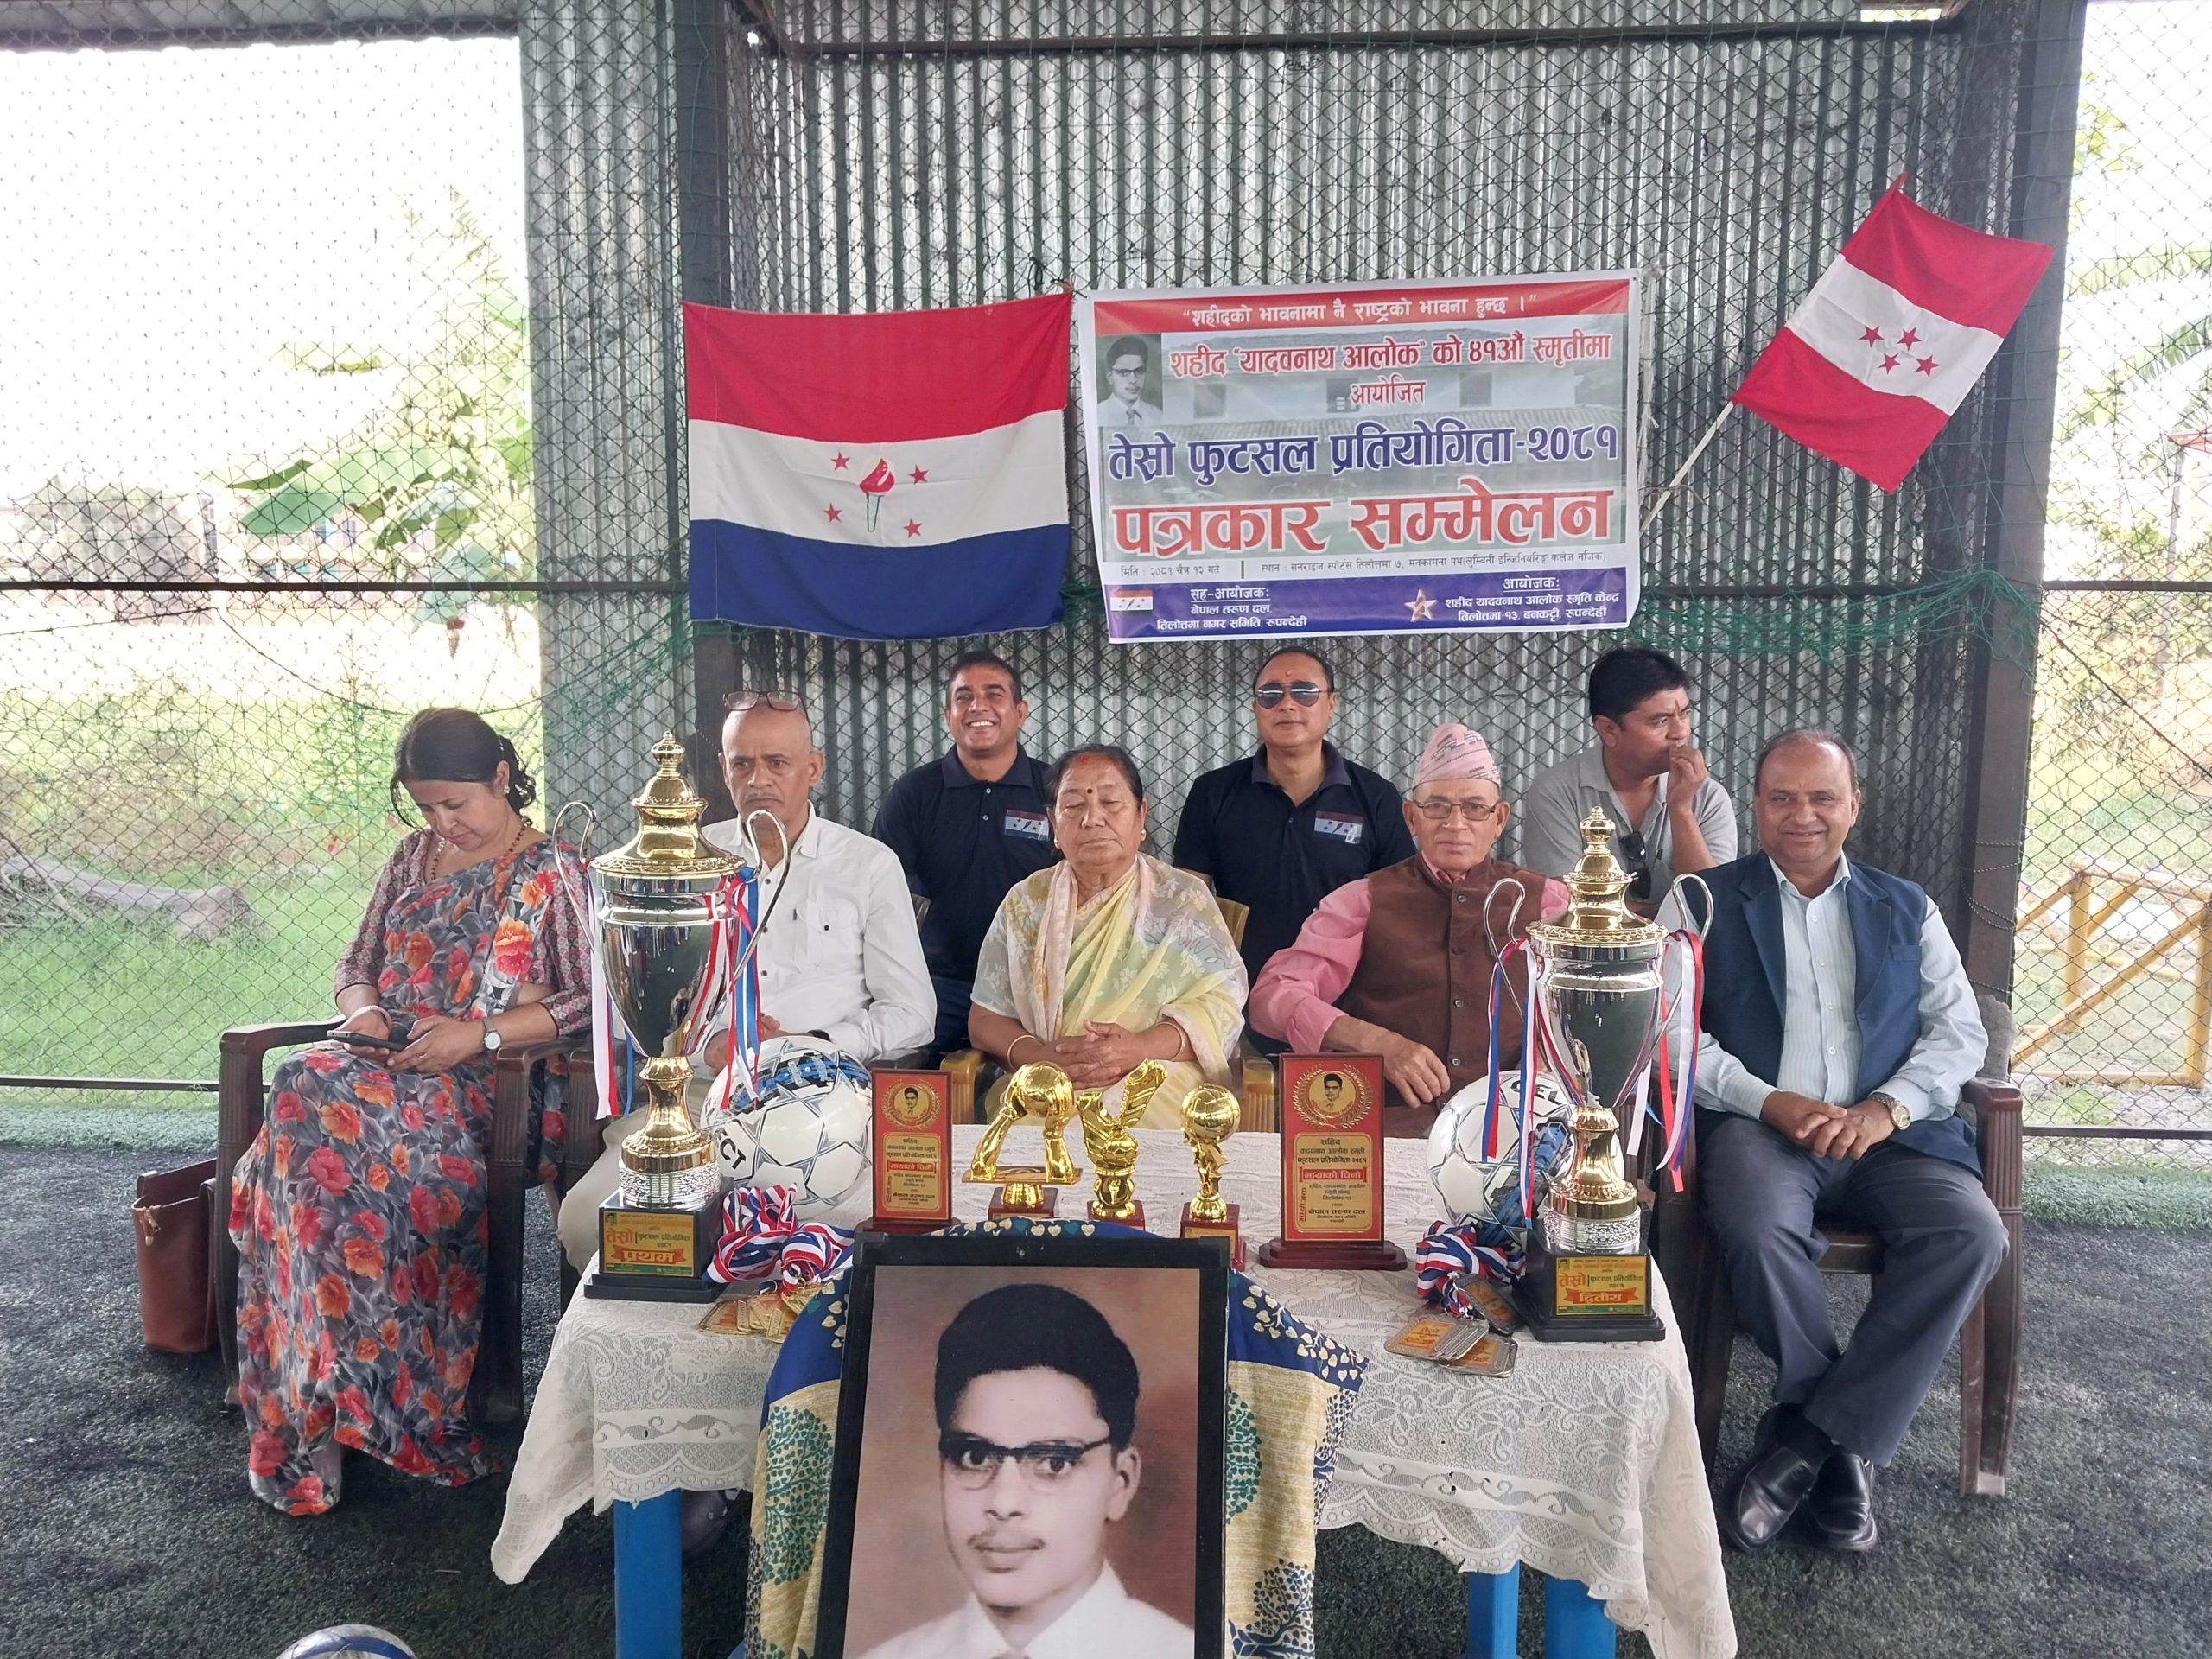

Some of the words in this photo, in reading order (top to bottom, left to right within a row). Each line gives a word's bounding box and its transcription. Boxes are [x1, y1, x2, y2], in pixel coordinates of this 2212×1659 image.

[1183, 304, 1252, 327] “शहीदको
[1259, 304, 1326, 322] भावनामा
[1333, 298, 1347, 319] नै
[1353, 297, 1413, 323] राष्ट्रको
[1419, 298, 1469, 316] भावना
[1475, 296, 1509, 318] हुन्छ
[1170, 344, 1227, 378] शहीद
[1233, 346, 1336, 375] “यादवनाथ
[1343, 336, 1427, 370] आलोक”
[1433, 333, 1463, 365] को
[1532, 327, 1611, 366] स्मृतीमा
[1350, 373, 1427, 405] आयोजित
[1108, 431, 1176, 483] तेस्रो
[1187, 435, 1319, 486] फुटसल
[1329, 416, 1618, 476] प्रतियोगिता-२०८१
[1111, 499, 1332, 557] पत्रकार
[1350, 476, 1615, 551] सम्मेलन
[1262, 563, 1280, 573] स्थान
[1291, 562, 1324, 571] सनराइज
[1408, 557, 1447, 568] मनकामना
[1551, 551, 1574, 562] कलेज
[1578, 549, 1607, 563] नजिक)
[1121, 565, 1139, 576] मिति
[1150, 567, 1173, 576] २०८१
[1176, 563, 1190, 575] चैत्र
[1193, 566, 1204, 575] १२
[1208, 563, 1220, 574] गते
[1503, 575, 1560, 591] आयोजक:
[1190, 585, 1270, 601] सह-आयोजक:
[1446, 596, 1472, 609] शहीद
[1476, 597, 1522, 607] यादवनाथ
[1525, 594, 1563, 605] आलोक
[1566, 592, 1592, 606] स्मृति
[1595, 591, 1621, 603] केन्द्र
[1190, 604, 1219, 615] नेपाल
[1203, 620, 1227, 629] नगर
[1304, 1170, 1338, 1179] मायाको
[1340, 1169, 1362, 1179] चिनो
[623, 1250, 675, 1263] प्रथम
[1580, 1292, 1622, 1303] द्वितीय
